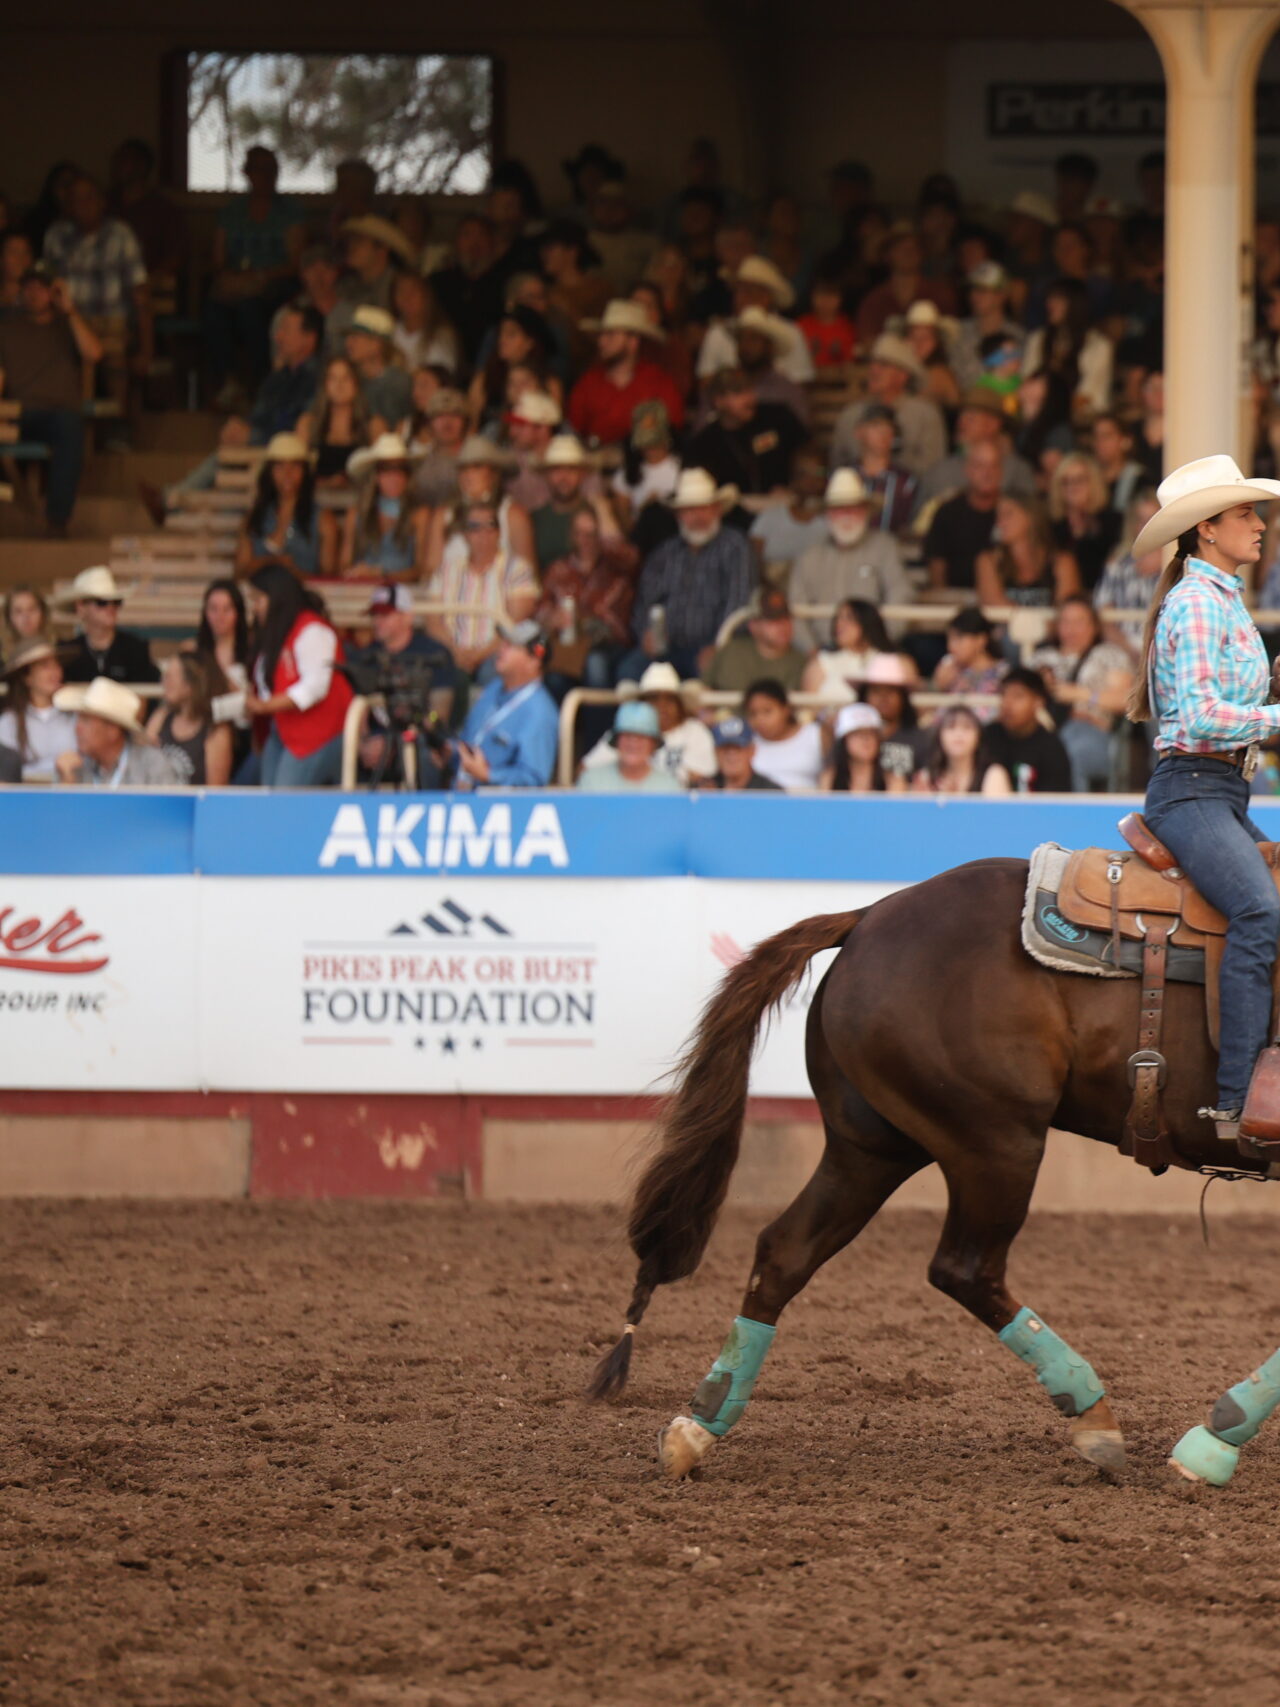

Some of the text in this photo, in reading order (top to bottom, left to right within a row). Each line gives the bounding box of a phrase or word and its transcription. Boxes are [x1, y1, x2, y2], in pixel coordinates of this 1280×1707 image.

[995, 91, 1166, 131] Perkin
[318, 803, 570, 868] AKIMA
[303, 955, 596, 983] PIKES PEAK OR BUST
[303, 988, 595, 1025] FOUNDATION
